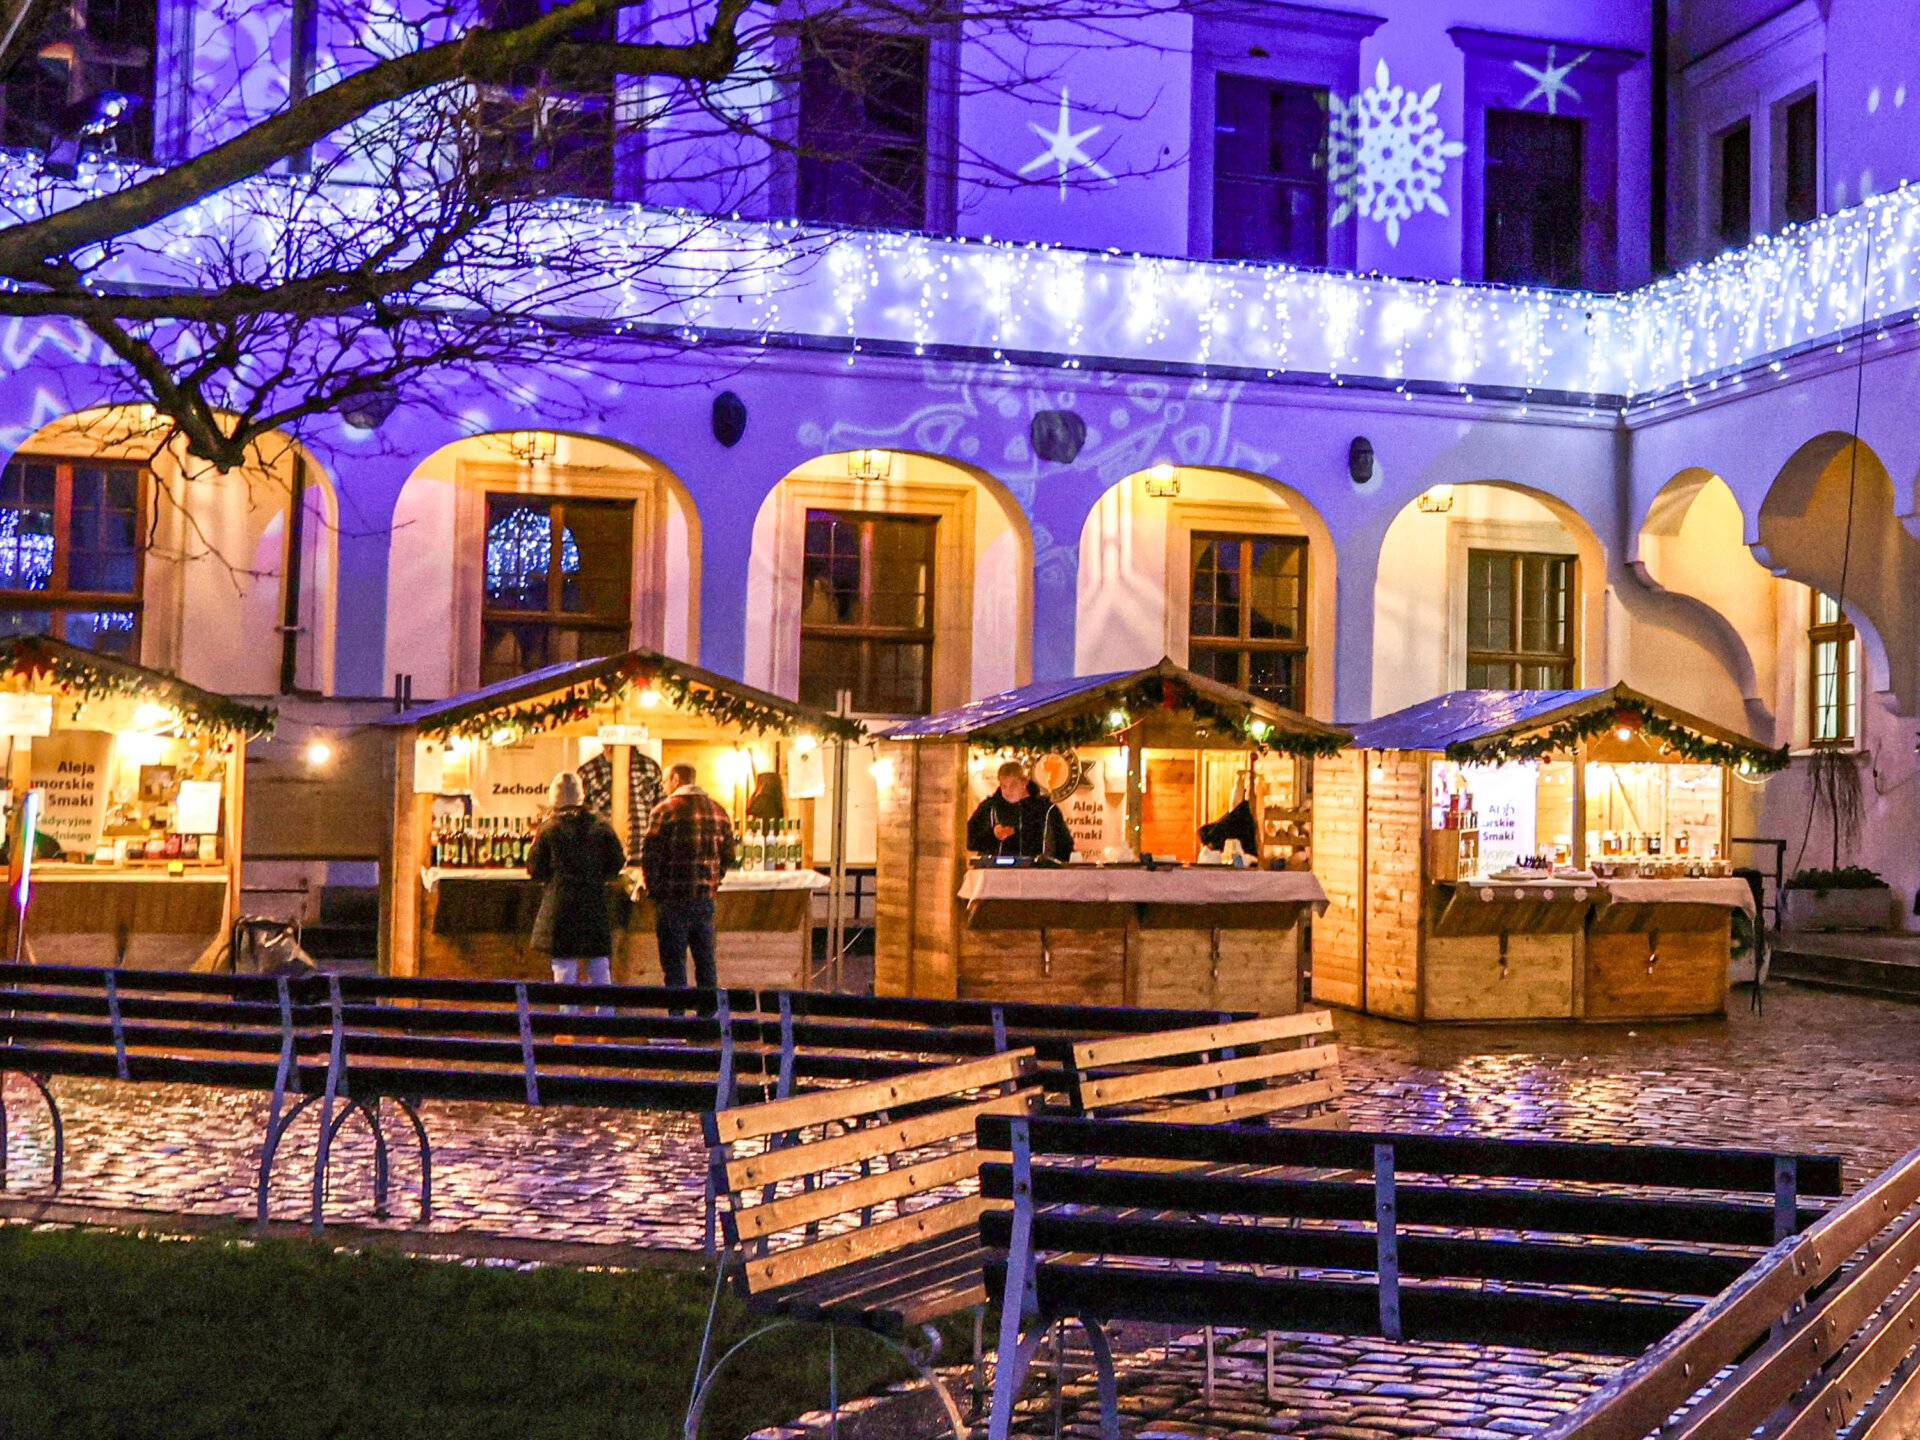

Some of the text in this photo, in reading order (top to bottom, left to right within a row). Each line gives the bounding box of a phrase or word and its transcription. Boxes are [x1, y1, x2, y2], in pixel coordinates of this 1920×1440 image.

[57, 760, 95, 776] Aleja
[31, 778, 94, 790] morskie
[48, 794, 94, 807] Smaki
[1073, 801, 1104, 814] Aleja
[40, 815, 92, 827] adycyjne
[1066, 815, 1104, 826] orskie
[52, 831, 92, 842] dniego
[1071, 829, 1103, 841] maki
[1483, 830, 1515, 841] Smaki
